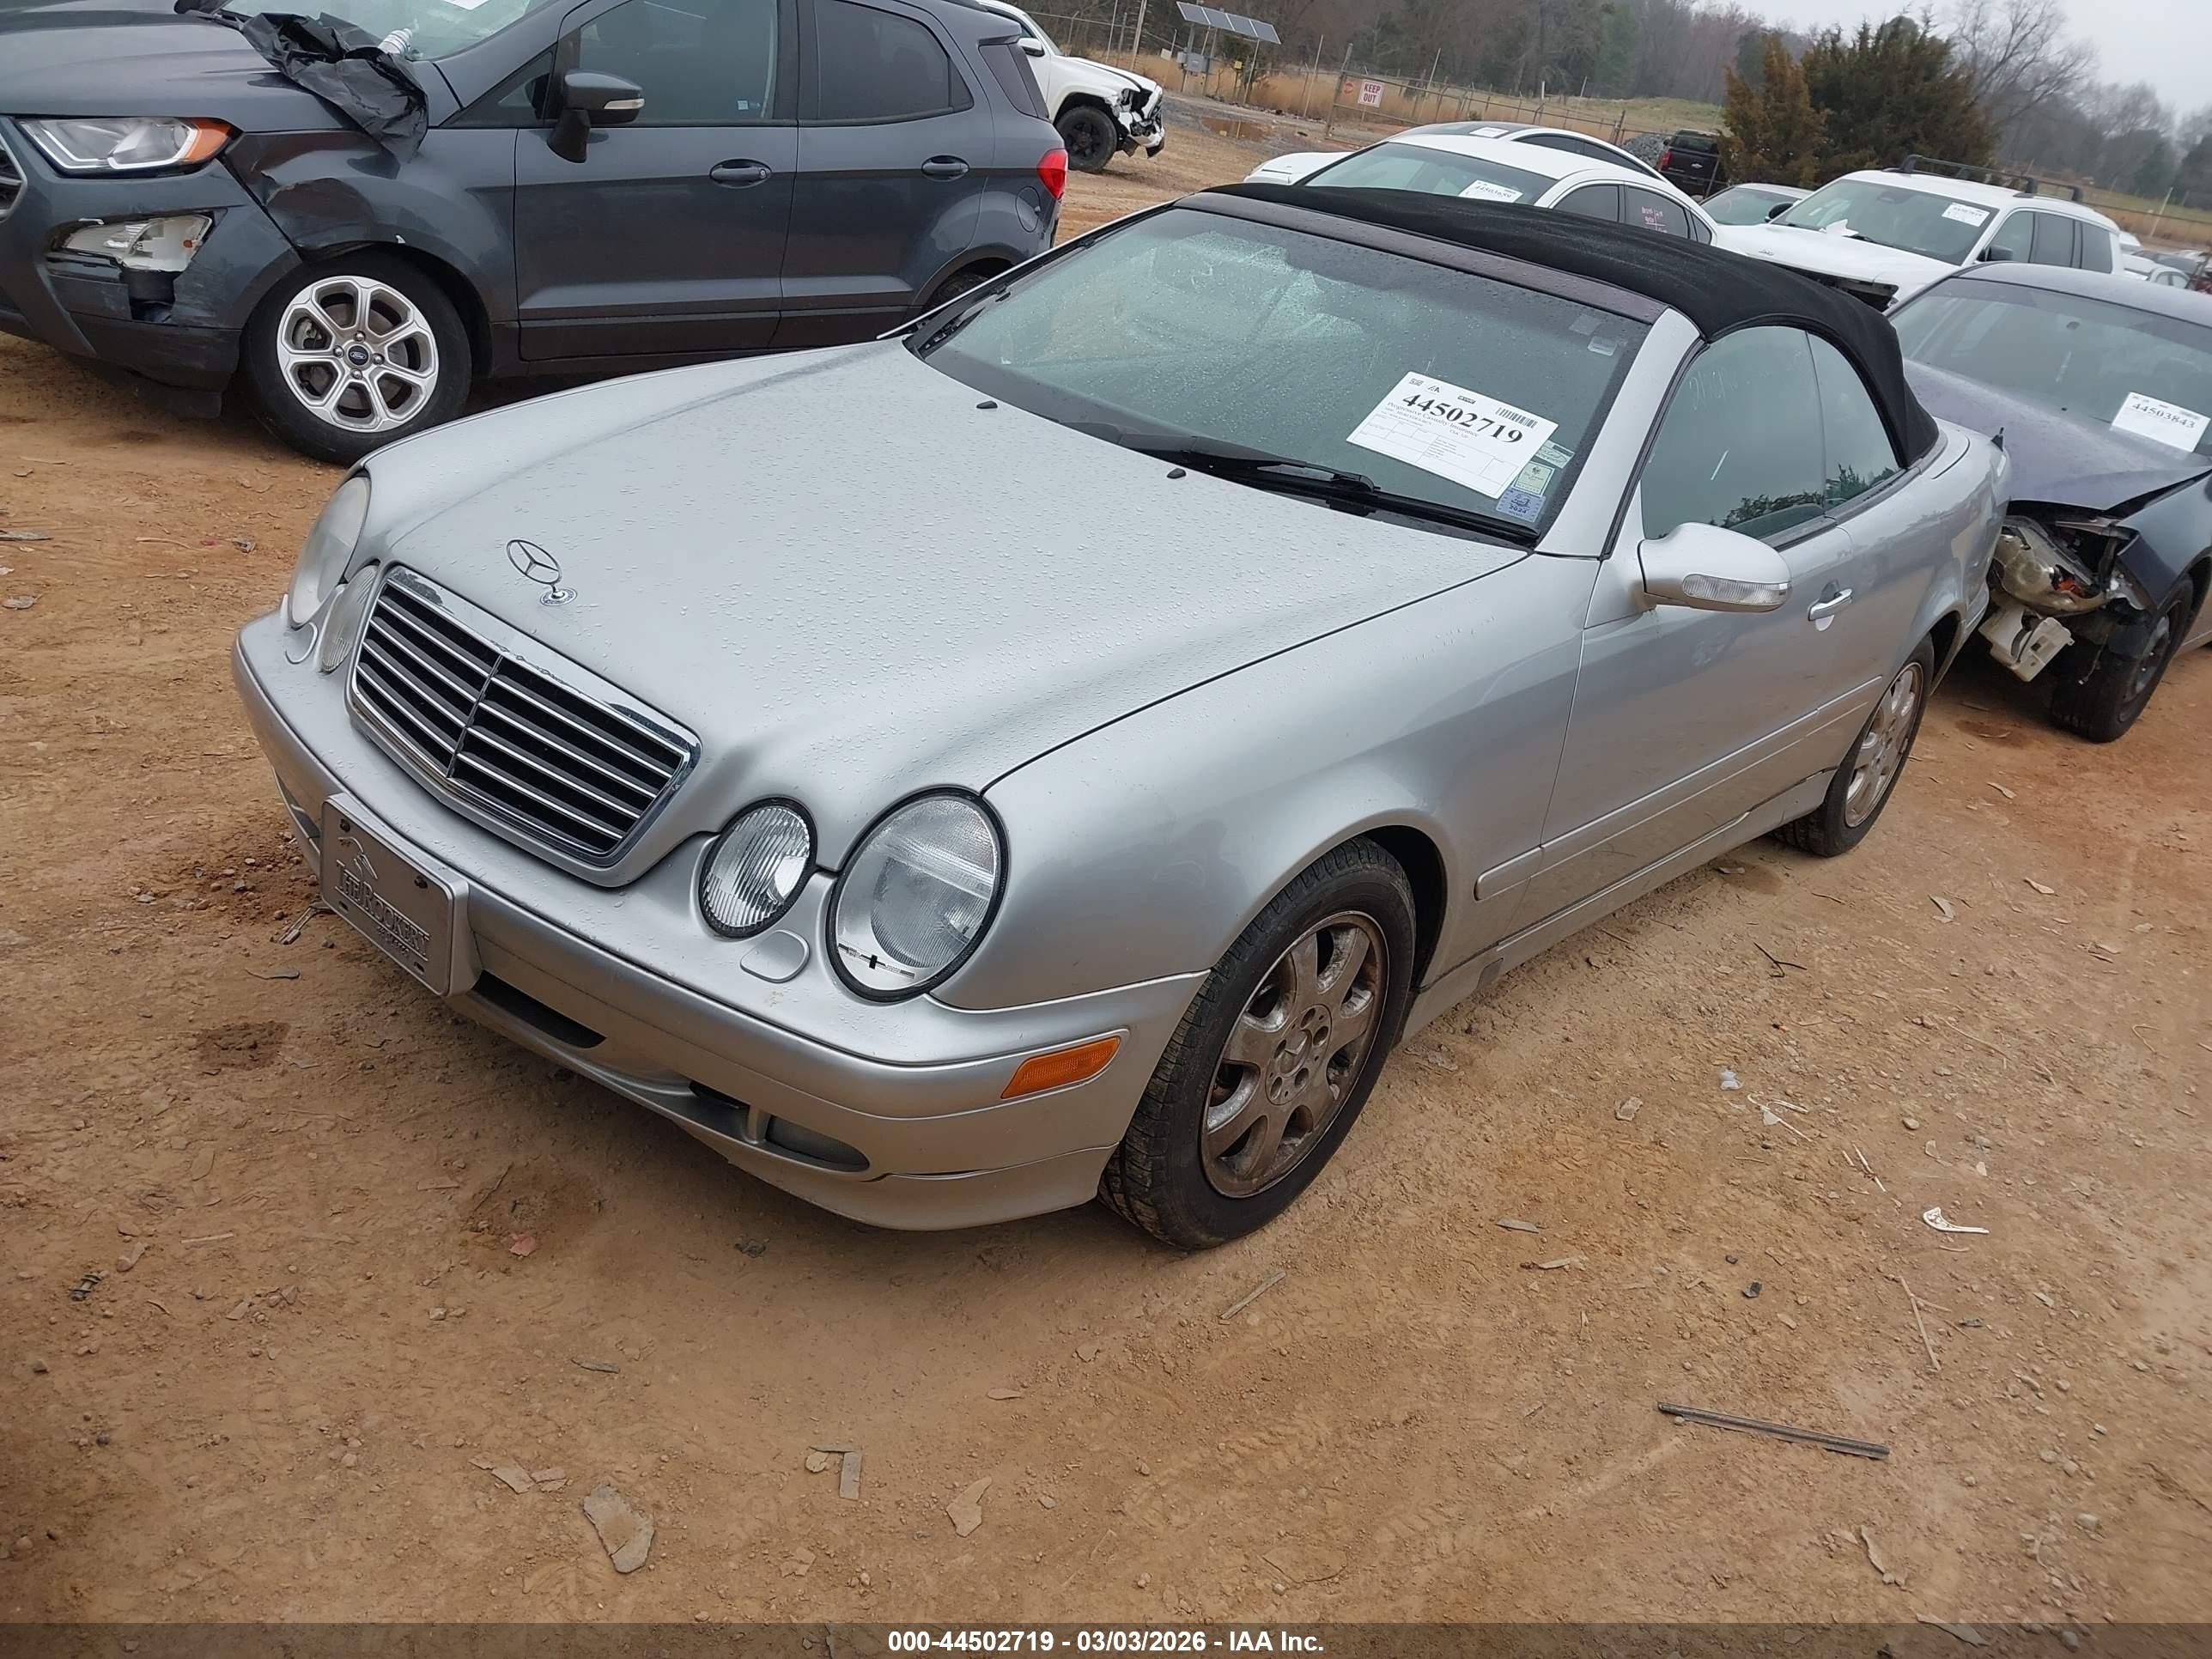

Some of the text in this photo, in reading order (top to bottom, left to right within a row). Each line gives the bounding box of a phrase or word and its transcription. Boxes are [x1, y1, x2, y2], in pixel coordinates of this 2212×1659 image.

[1363, 94, 1377, 103] OUT
[1364, 82, 1381, 94] KEEP
[1402, 394, 1523, 443] 44502719
[2131, 404, 2196, 428] 44503843
[336, 860, 362, 902] THE
